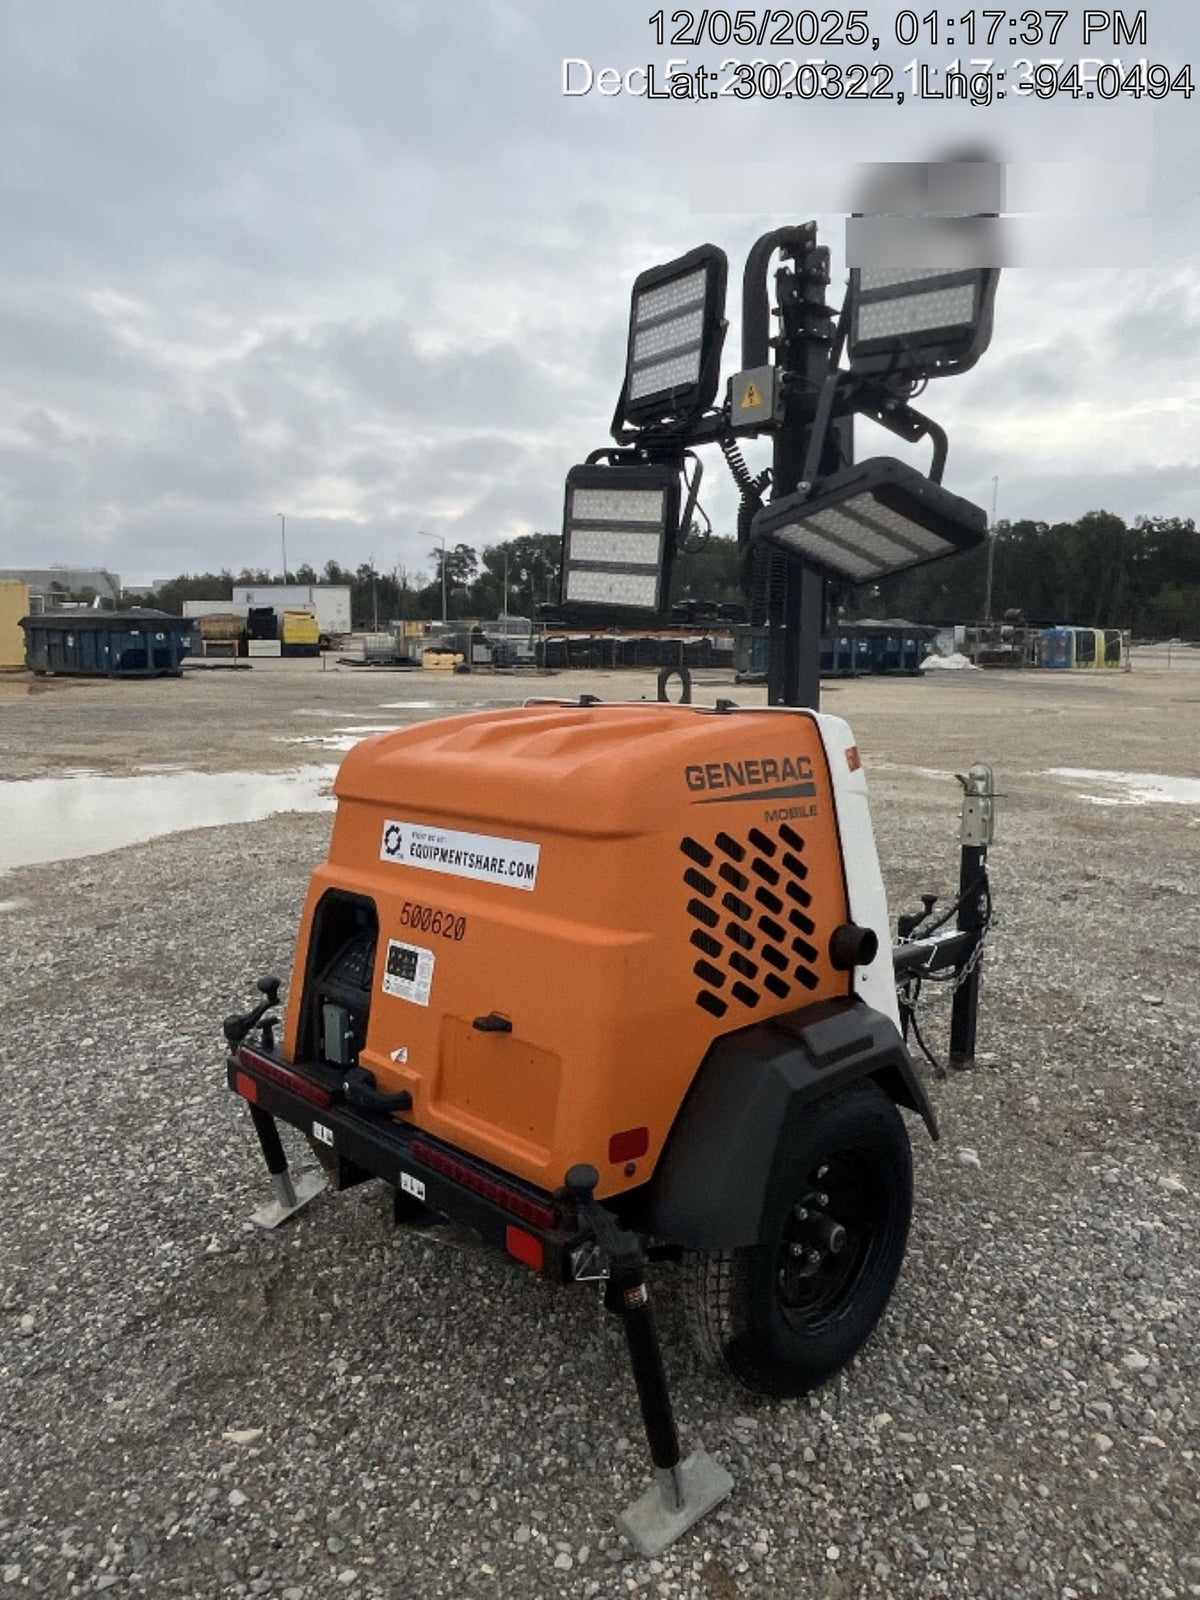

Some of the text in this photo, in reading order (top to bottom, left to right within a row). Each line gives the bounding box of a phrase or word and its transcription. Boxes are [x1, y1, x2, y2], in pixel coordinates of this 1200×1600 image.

[685, 756, 814, 792] GENERAC
[764, 804, 818, 823] MOBILE
[410, 842, 535, 881] EQUIPMENTSHARE.COM
[400, 902, 467, 941] 500620
